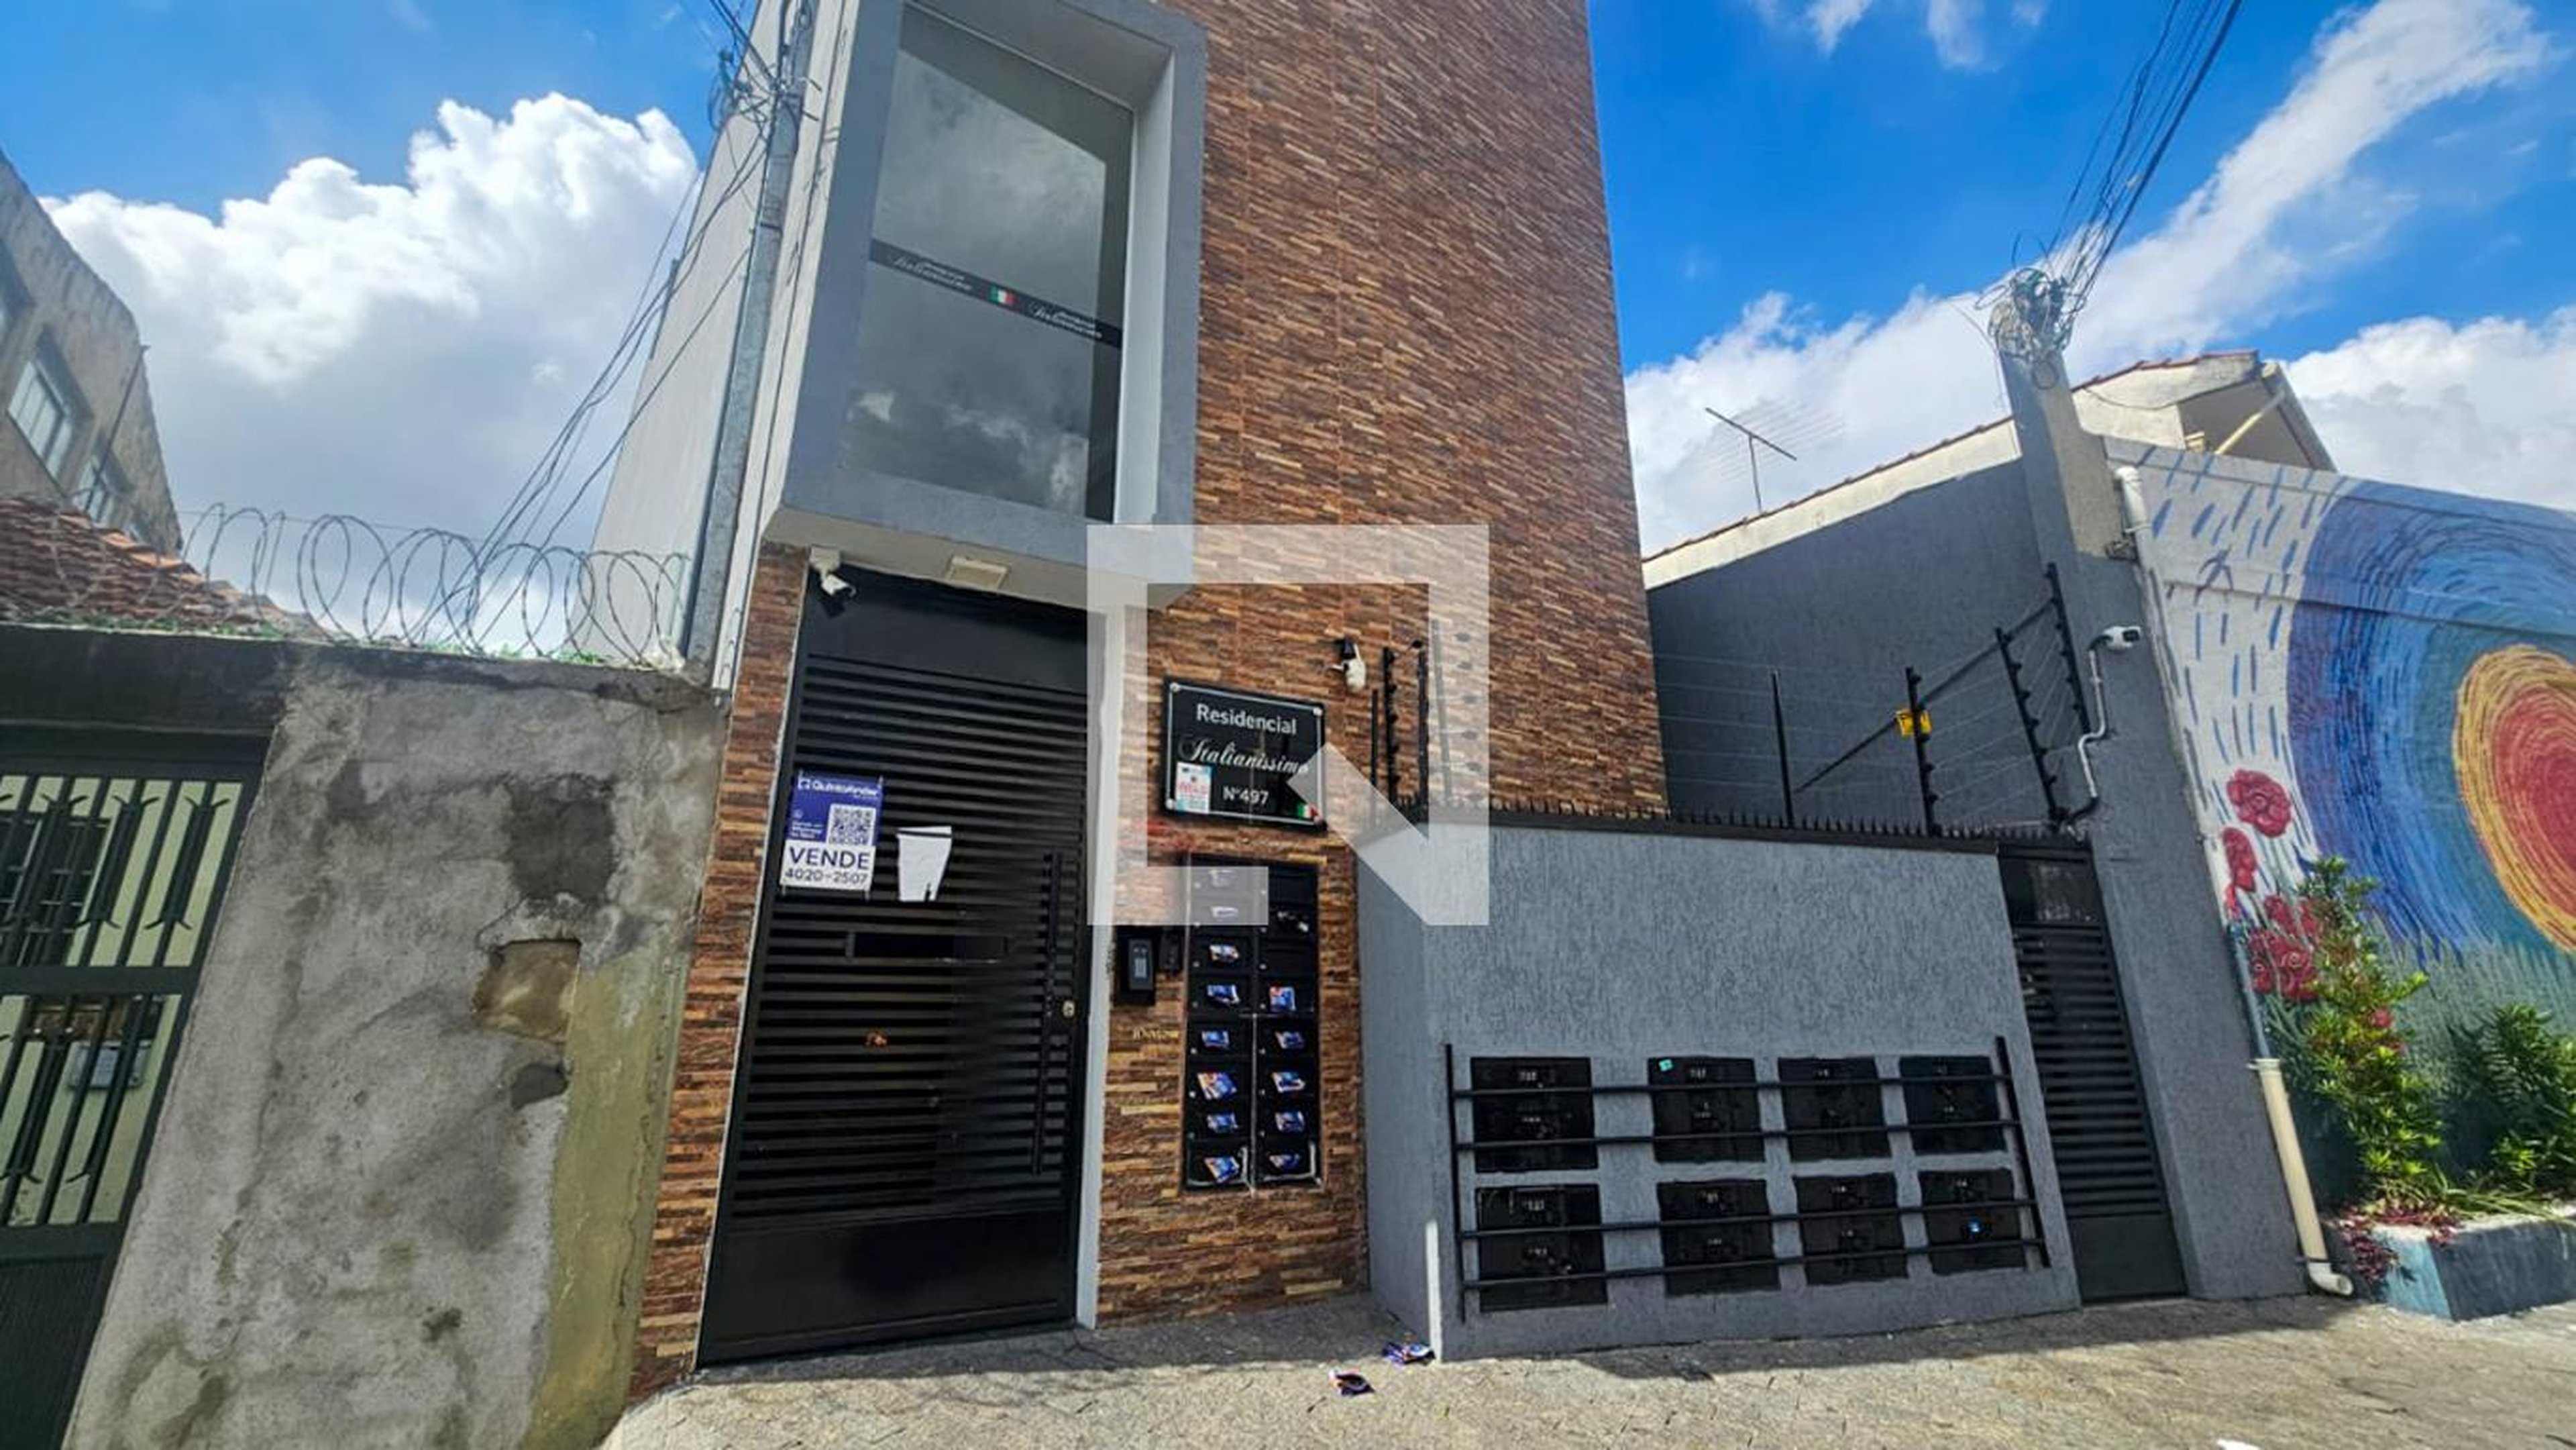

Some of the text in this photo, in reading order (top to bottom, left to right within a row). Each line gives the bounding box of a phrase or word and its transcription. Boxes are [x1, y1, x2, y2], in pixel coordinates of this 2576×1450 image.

[1196, 703, 1297, 735] Residencial
[790, 845, 870, 870] VENDE
[785, 868, 868, 884] 4020-2507
